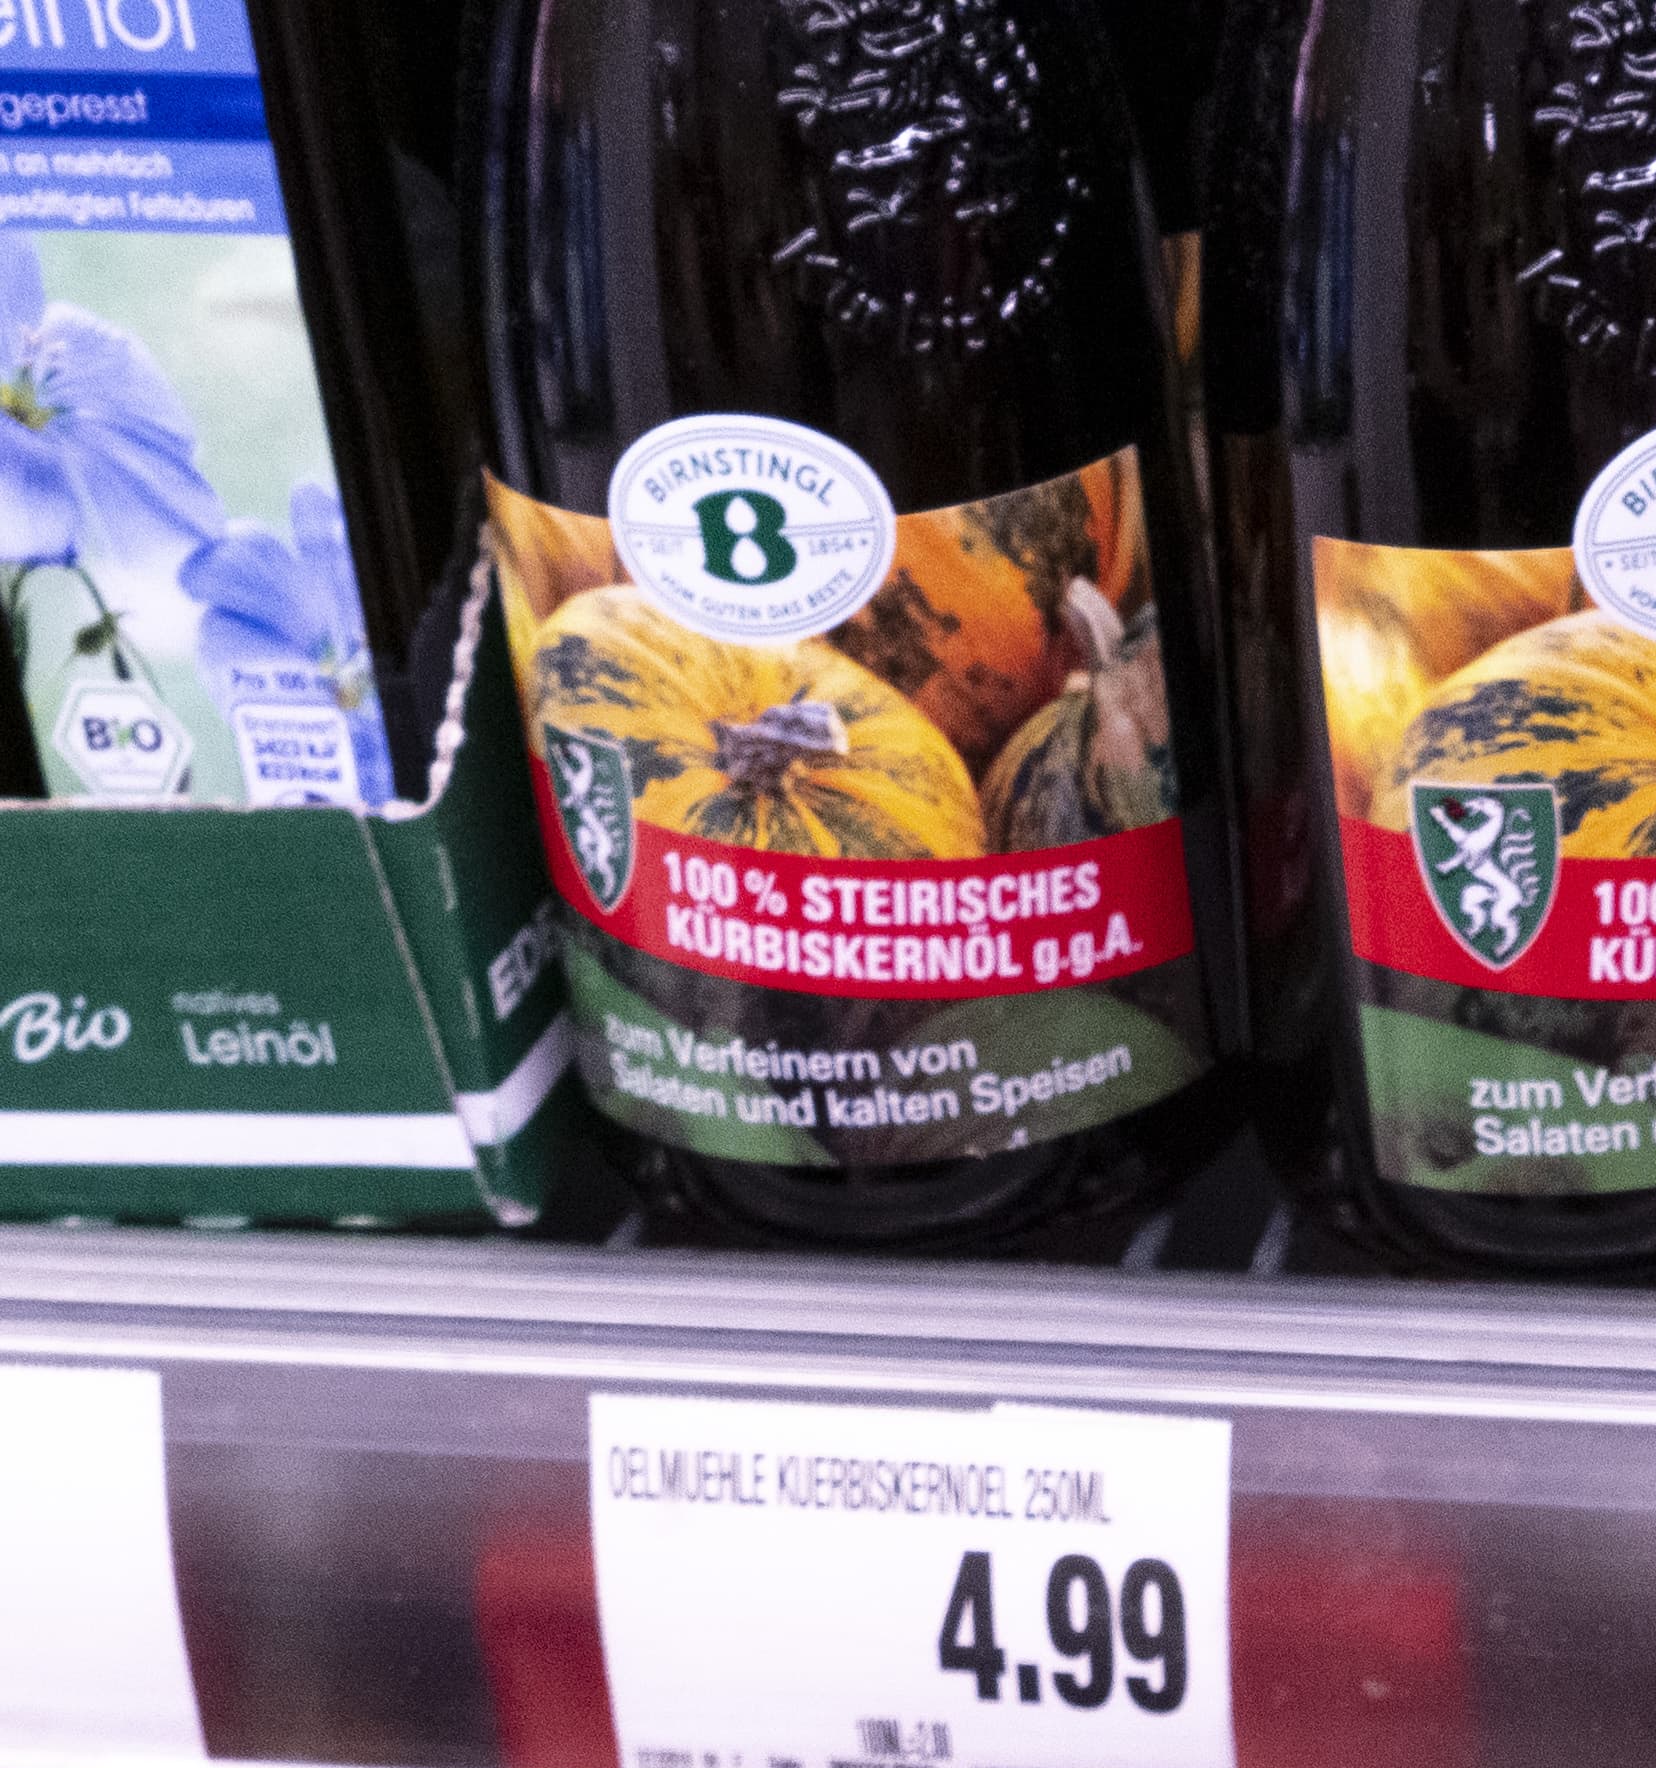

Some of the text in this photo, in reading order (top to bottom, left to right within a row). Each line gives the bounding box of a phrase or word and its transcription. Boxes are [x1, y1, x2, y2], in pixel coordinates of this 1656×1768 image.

[642, 446, 836, 508] BIRNSTINGL
[663, 850, 1101, 928] 100 % STEIRISCHES
[665, 905, 1145, 984] KÜRBISKERNÖL g.g.A.
[0, 991, 131, 1063] Bio
[181, 1017, 337, 1066] Leinöl
[604, 1015, 978, 1082] zum Verfeinern von
[609, 1038, 1132, 1130] Salaten und kalten Speisen
[1471, 1074, 1564, 1111] zum
[1472, 1116, 1640, 1157] Salaten
[610, 1445, 767, 1507] OELMUEHLE
[777, 1454, 1014, 1521] KUERBISKERNOEL
[938, 1550, 1190, 1716] 4.99
